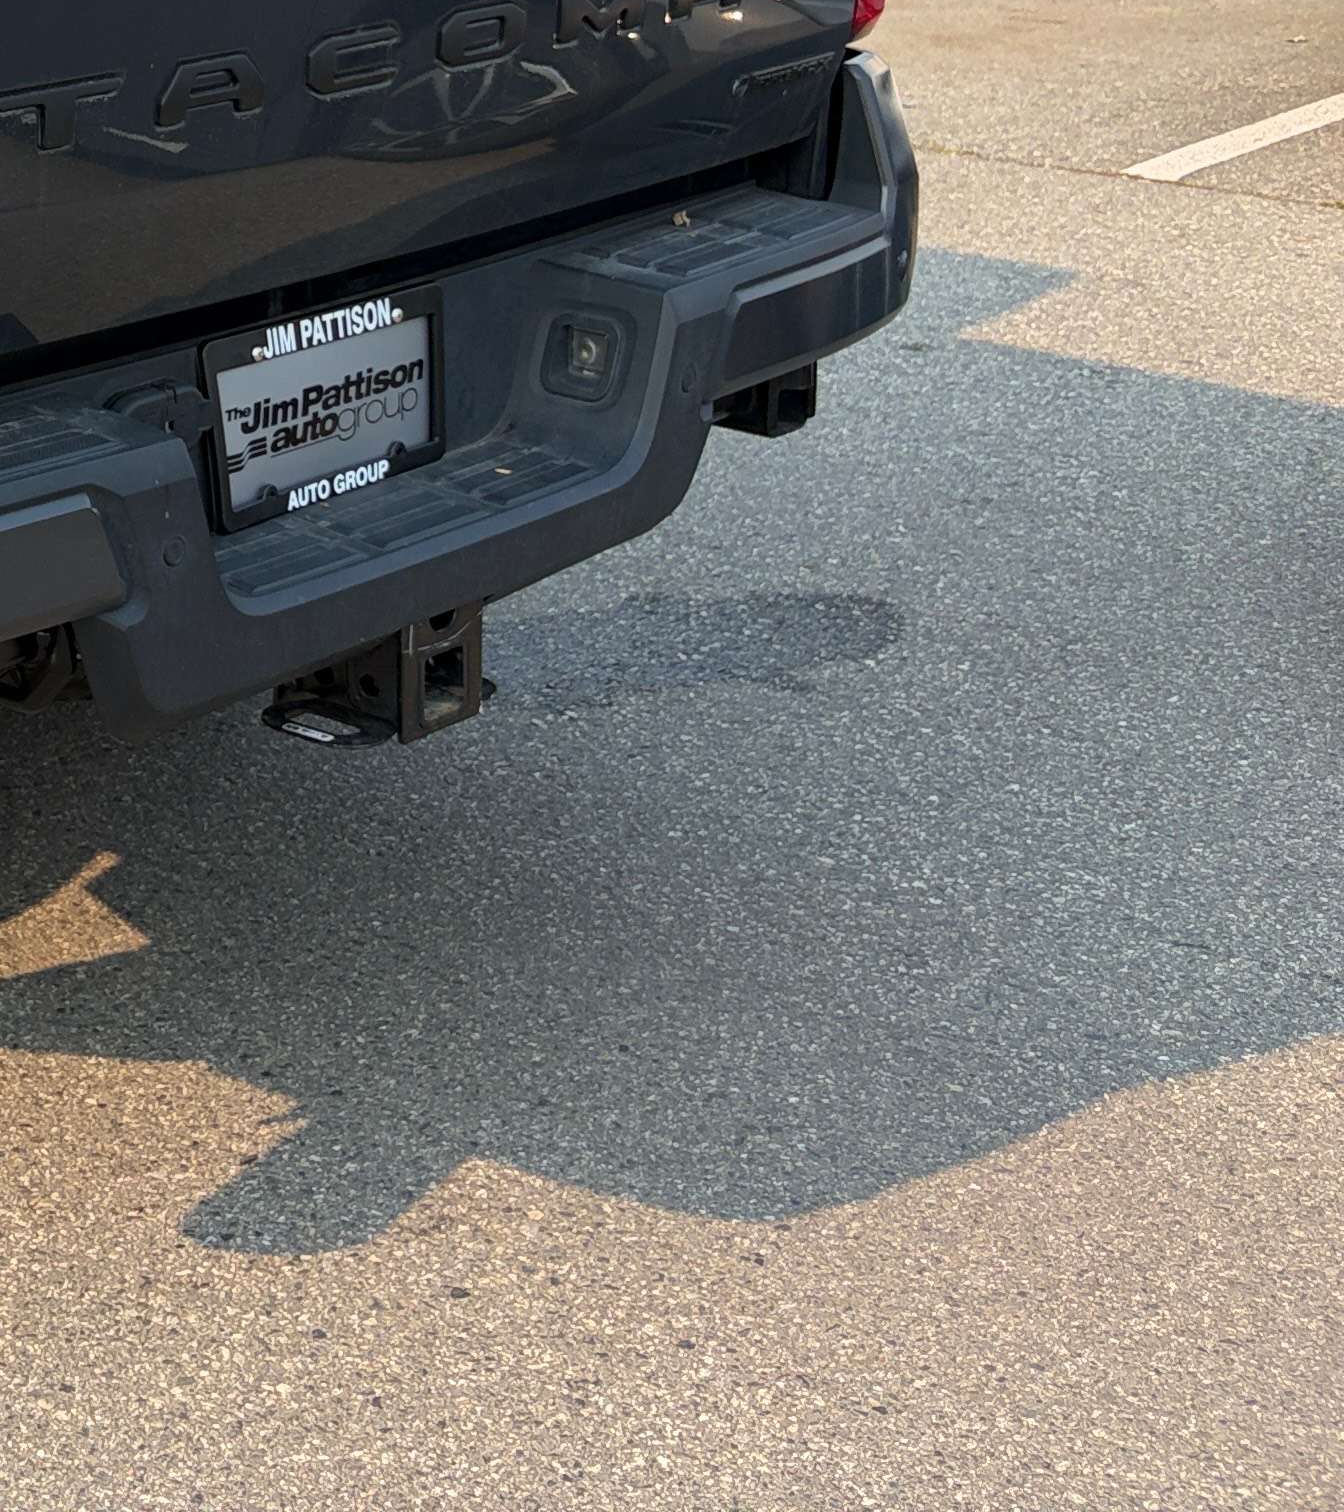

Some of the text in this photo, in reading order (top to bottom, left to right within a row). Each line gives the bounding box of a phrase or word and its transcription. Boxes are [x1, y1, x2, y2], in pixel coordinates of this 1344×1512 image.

[262, 297, 392, 359] JIM PATTISON
[225, 358, 425, 435] The Jim Pattison
[287, 459, 391, 512] AUTO GROUP
